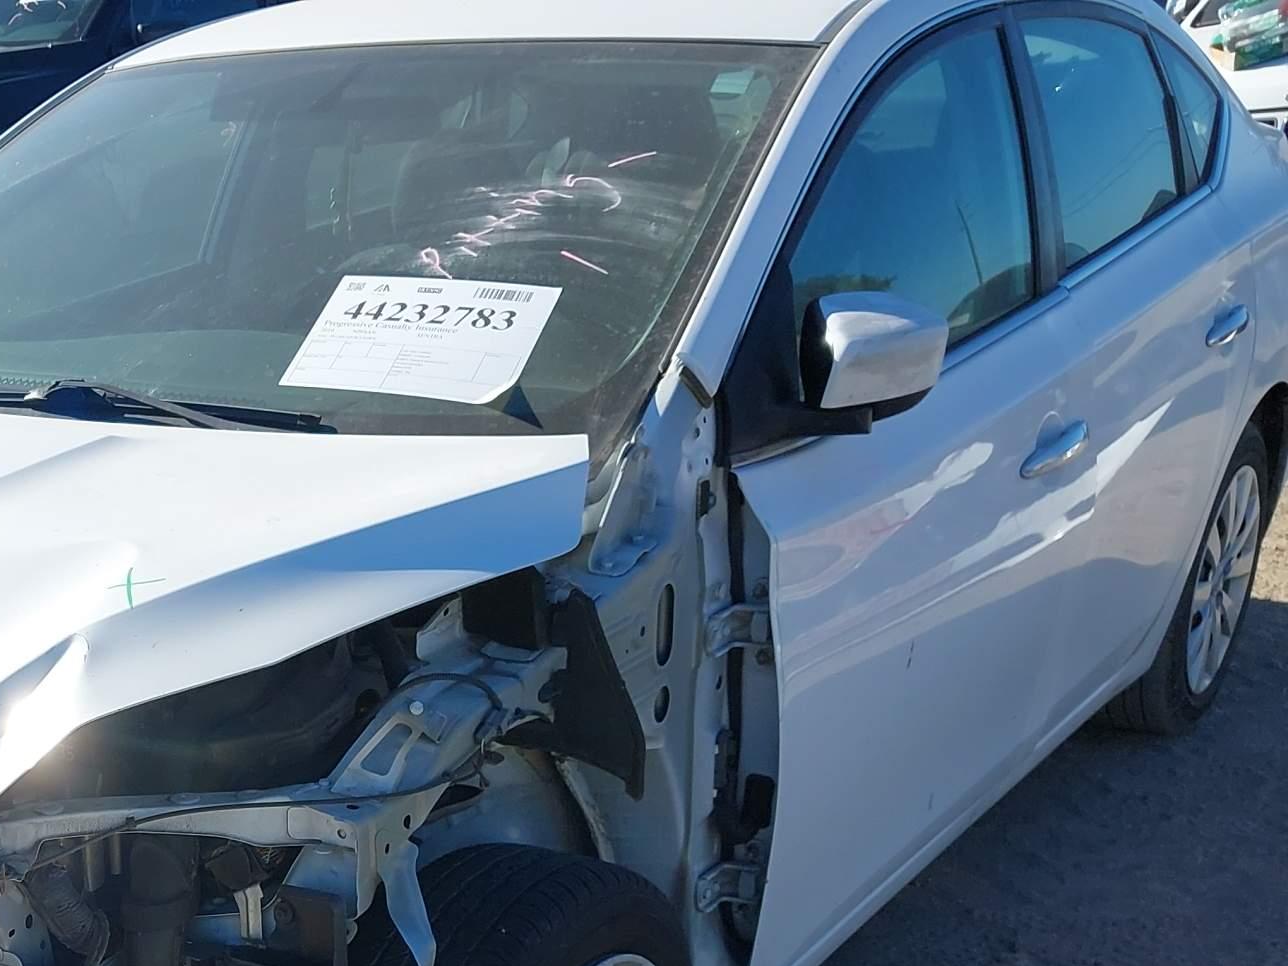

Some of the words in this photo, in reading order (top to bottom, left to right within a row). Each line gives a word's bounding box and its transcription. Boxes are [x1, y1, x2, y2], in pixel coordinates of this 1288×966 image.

[324, 319, 374, 330] Progressive
[375, 321, 412, 332] Casualty
[415, 323, 460, 334] Insurance
[343, 300, 517, 331] 44232783
